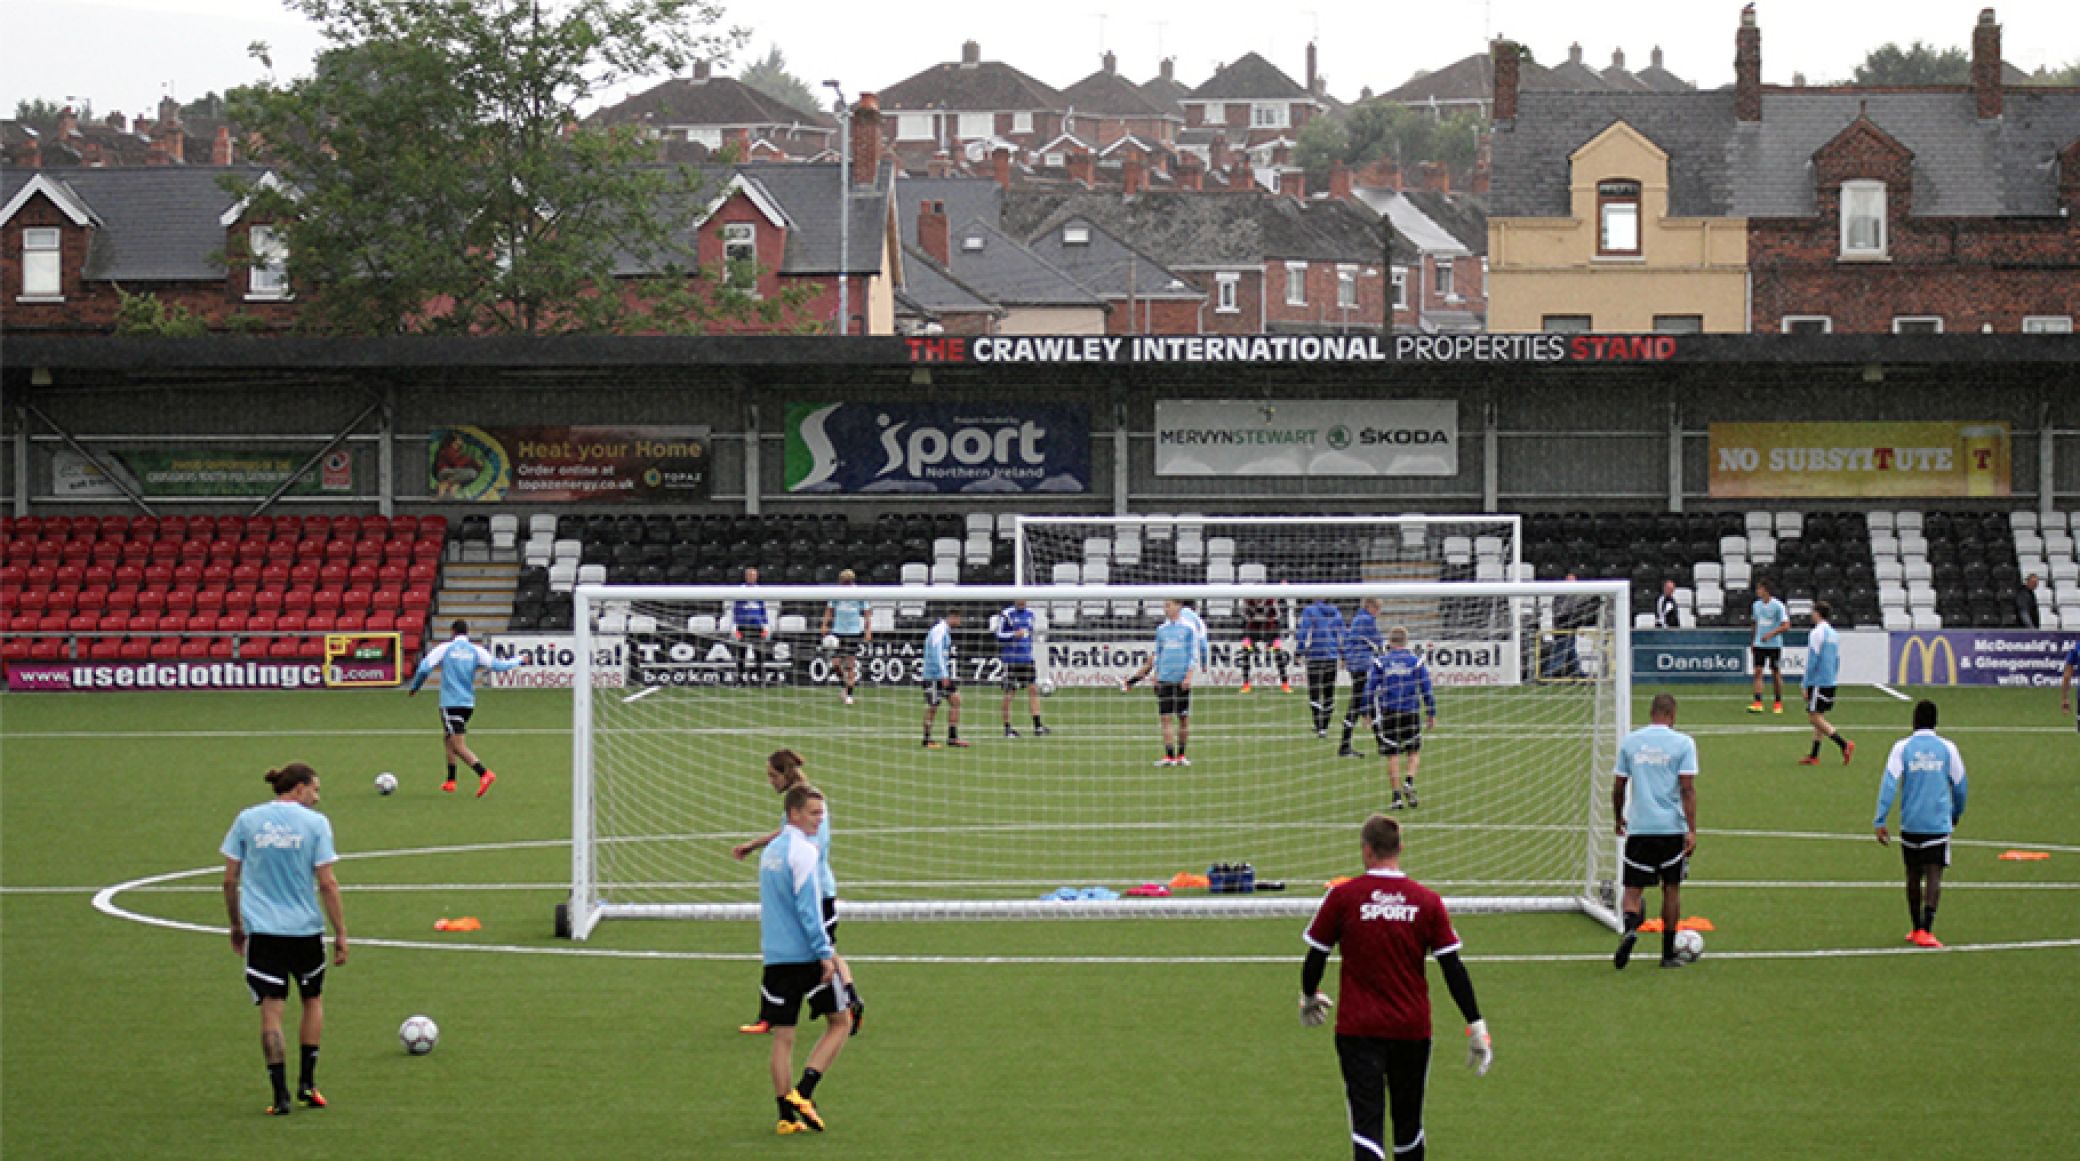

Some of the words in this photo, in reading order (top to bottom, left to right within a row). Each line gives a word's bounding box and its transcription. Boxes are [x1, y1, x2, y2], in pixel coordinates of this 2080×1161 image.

[905, 338, 966, 361] THE
[973, 338, 1122, 361] CRAWLEY
[1132, 337, 1386, 361] INTERNATIONAL
[1396, 336, 1564, 361] PROPERTIES
[1571, 336, 1677, 360] STAND
[1159, 429, 1318, 445] MERVYNSTEWART
[1359, 426, 1449, 445] ŠKODA
[518, 440, 571, 459] Heat
[577, 444, 628, 464] your
[634, 440, 703, 459] Home
[1717, 447, 1760, 472] NO
[1768, 446, 1954, 473] SUBSTITUTE
[517, 464, 556, 477] Order
[559, 464, 598, 477] online
[601, 464, 616, 477] at
[925, 466, 990, 479] Northern
[994, 466, 1045, 479] Ireland
[496, 642, 622, 667] Natioal
[1974, 639, 2057, 652] McDonald's
[870, 657, 904, 681] 90
[911, 657, 961, 681] 31
[1656, 652, 1741, 671] Danske
[1960, 656, 1971, 669] &
[1996, 674, 2029, 687] with
[254, 833, 305, 849] SPORT
[1359, 903, 1420, 922] SPORT
